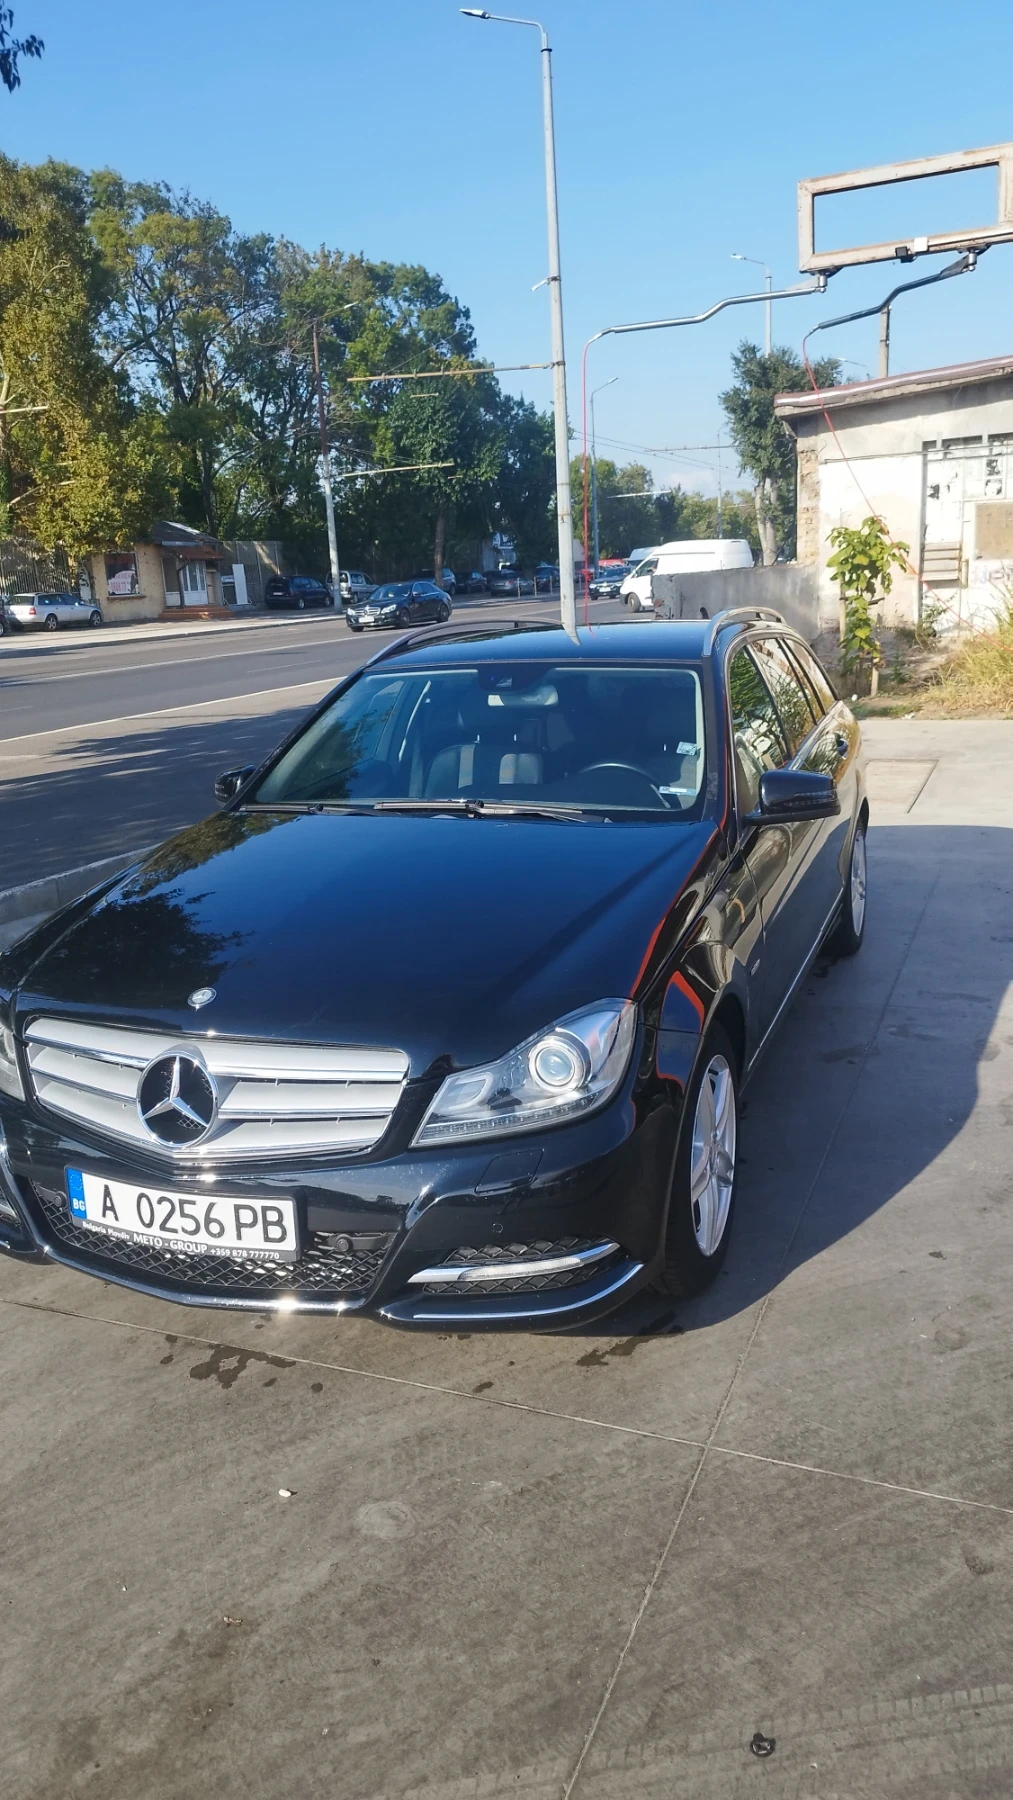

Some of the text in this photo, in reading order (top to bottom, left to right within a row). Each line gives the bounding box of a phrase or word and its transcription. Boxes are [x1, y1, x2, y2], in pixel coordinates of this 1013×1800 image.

[73, 1198, 86, 1212] BG
[102, 1184, 288, 1244] A 0256 PB
[82, 1220, 107, 1234] Bulgaria
[133, 1232, 163, 1247] METO
[169, 1240, 208, 1254] GROUP
[210, 1248, 230, 1257] +359
[232, 1249, 248, 1258] 878
[249, 1250, 280, 1260] 777770
